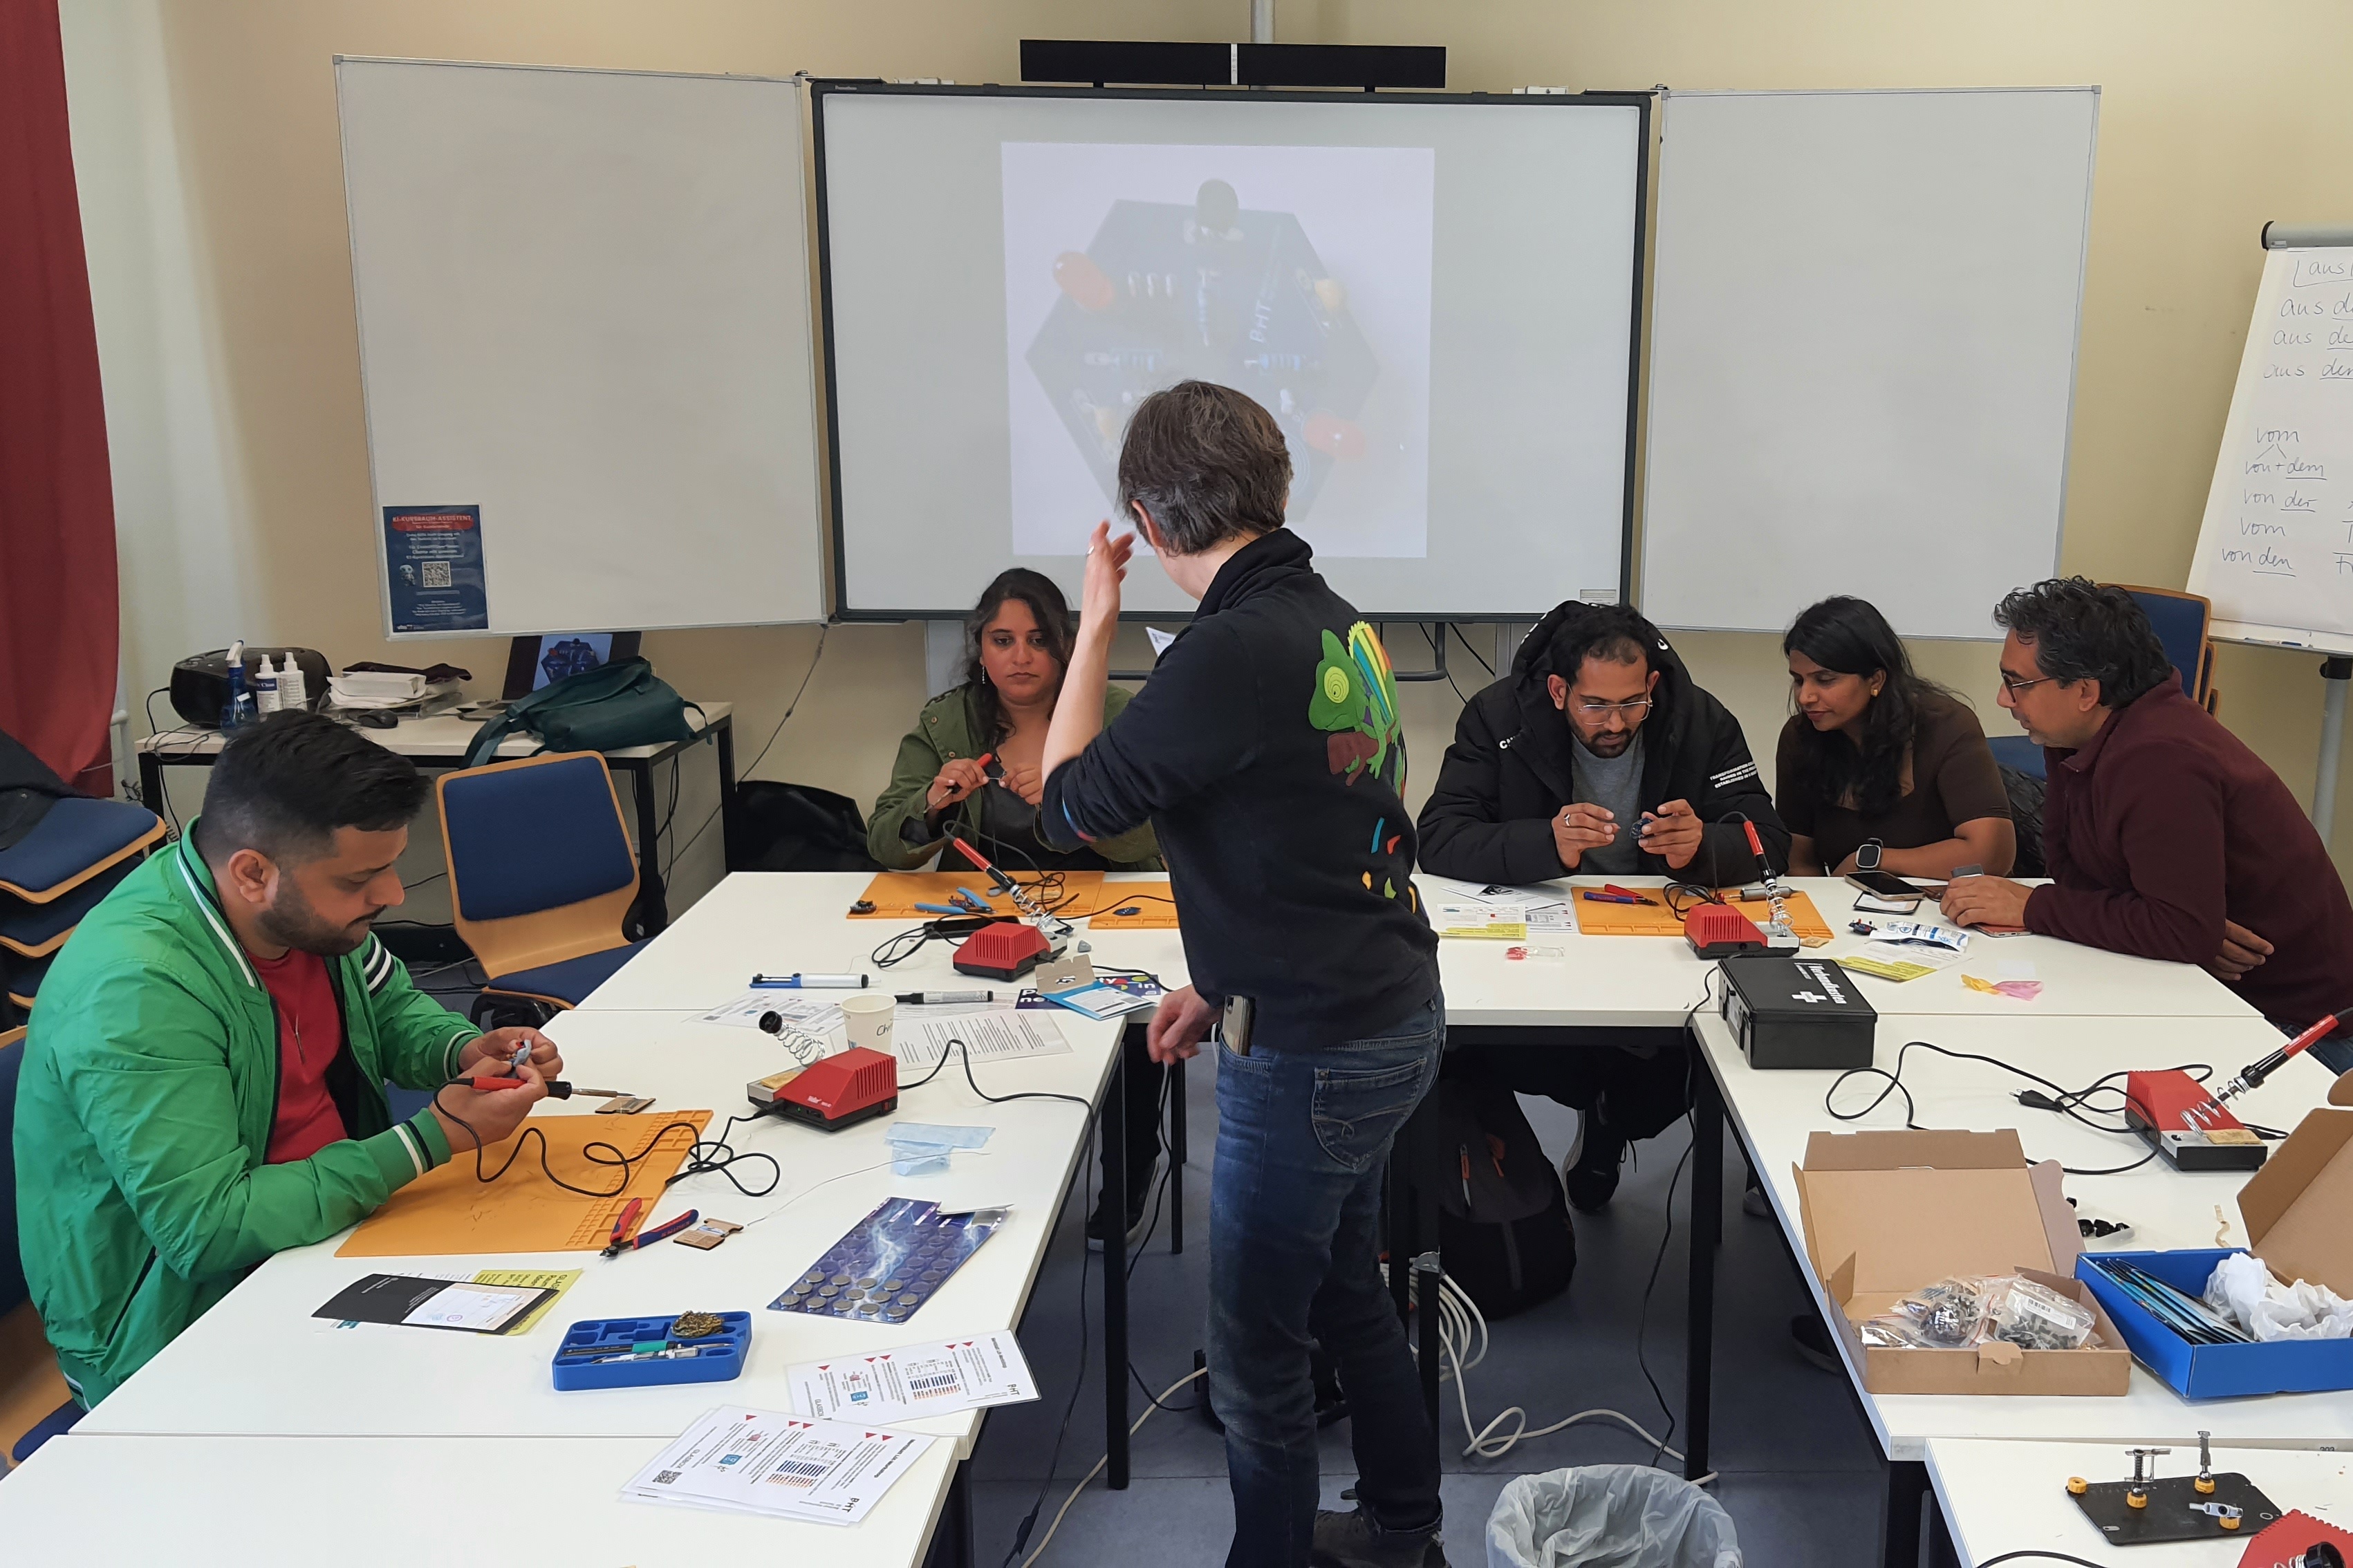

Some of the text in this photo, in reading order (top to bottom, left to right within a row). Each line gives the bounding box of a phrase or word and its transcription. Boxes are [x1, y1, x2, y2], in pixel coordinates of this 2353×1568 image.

[2309, 261, 2345, 276] aus
[2280, 298, 2324, 317] aus
[2273, 329, 2312, 346] aus
[2258, 545, 2294, 570] den
[841, 1496, 860, 1513] BHT
